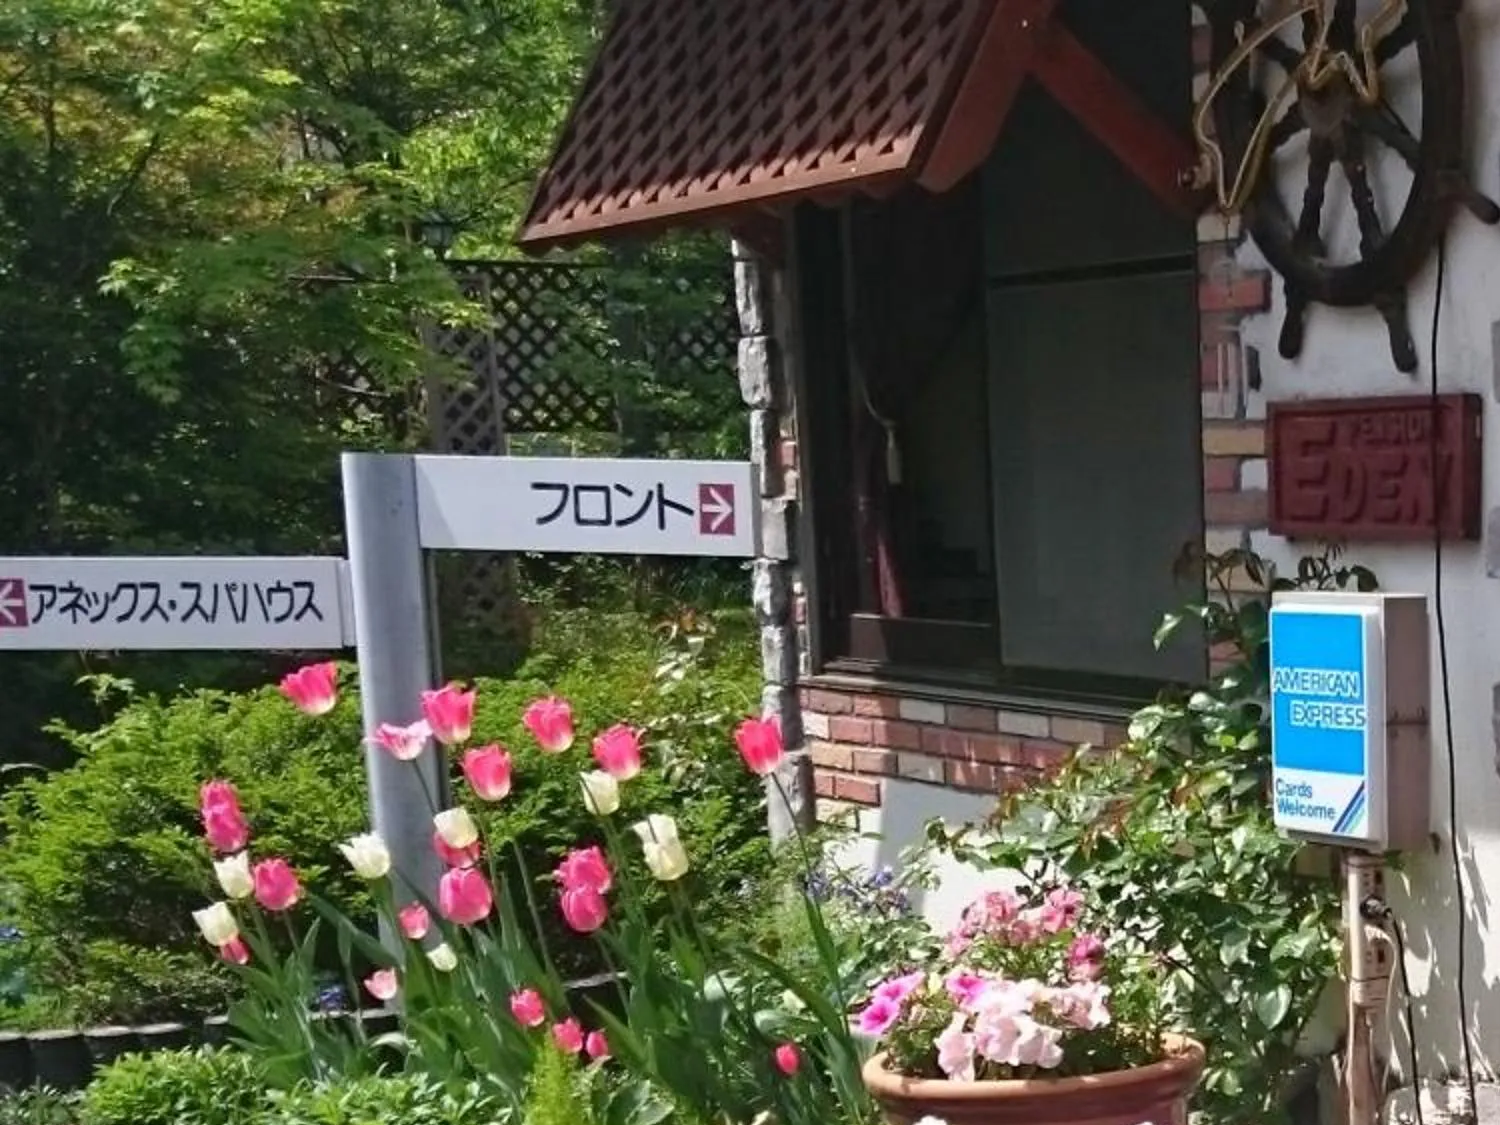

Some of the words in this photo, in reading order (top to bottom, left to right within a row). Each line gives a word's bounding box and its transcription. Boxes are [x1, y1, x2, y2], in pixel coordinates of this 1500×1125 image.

[1283, 417, 1452, 523] EDEN
[531, 482, 694, 530] フロント
[29, 580, 323, 624] アネックス・スパハウス
[1274, 669, 1357, 694] AMERICAN
[1292, 703, 1366, 727] EXPRESS
[1276, 778, 1313, 799] Cards
[1277, 798, 1337, 820] Welcome
